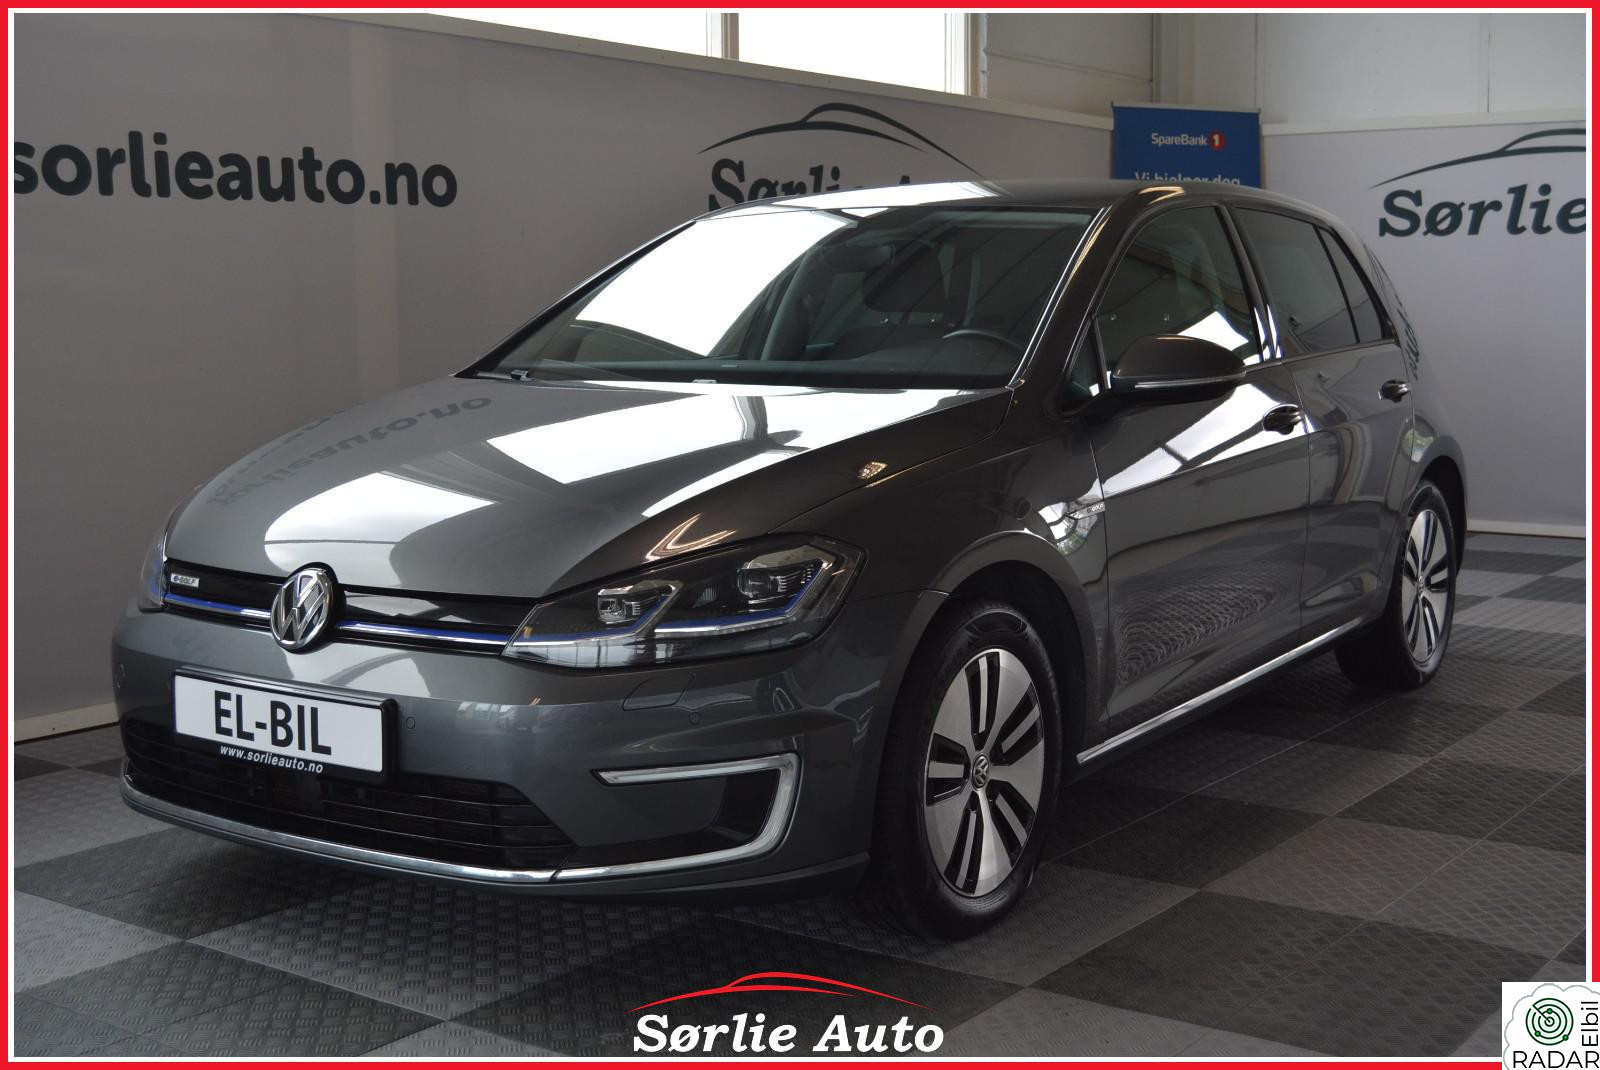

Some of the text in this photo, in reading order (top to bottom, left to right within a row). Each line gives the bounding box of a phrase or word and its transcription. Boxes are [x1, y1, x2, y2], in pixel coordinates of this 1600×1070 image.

[1151, 132, 1220, 147] SpareBank 1
[14, 131, 457, 207] sorlieauto.no
[708, 158, 863, 211] Sørli
[1379, 184, 1586, 237] Sørlie
[214, 690, 332, 756] EL-BIL
[220, 745, 324, 774] www.sorlieauto.no
